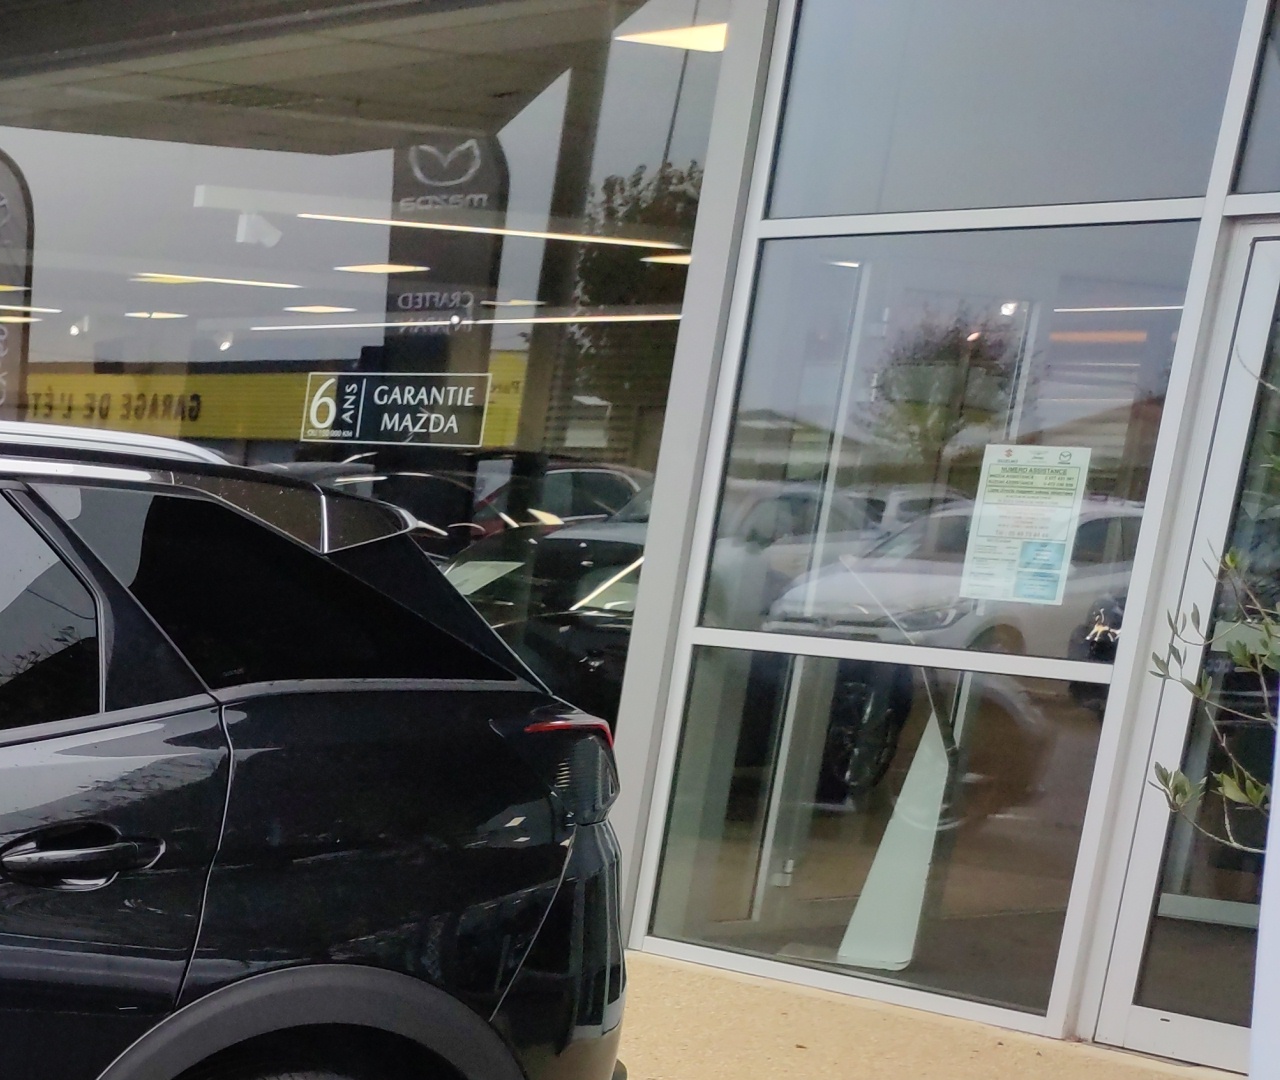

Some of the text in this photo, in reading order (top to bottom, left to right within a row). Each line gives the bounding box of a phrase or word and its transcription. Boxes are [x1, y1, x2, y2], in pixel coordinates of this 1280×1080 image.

[309, 377, 359, 430] 6 ANS
[373, 385, 476, 407] GARANTIE
[379, 411, 459, 434] MAZDA
